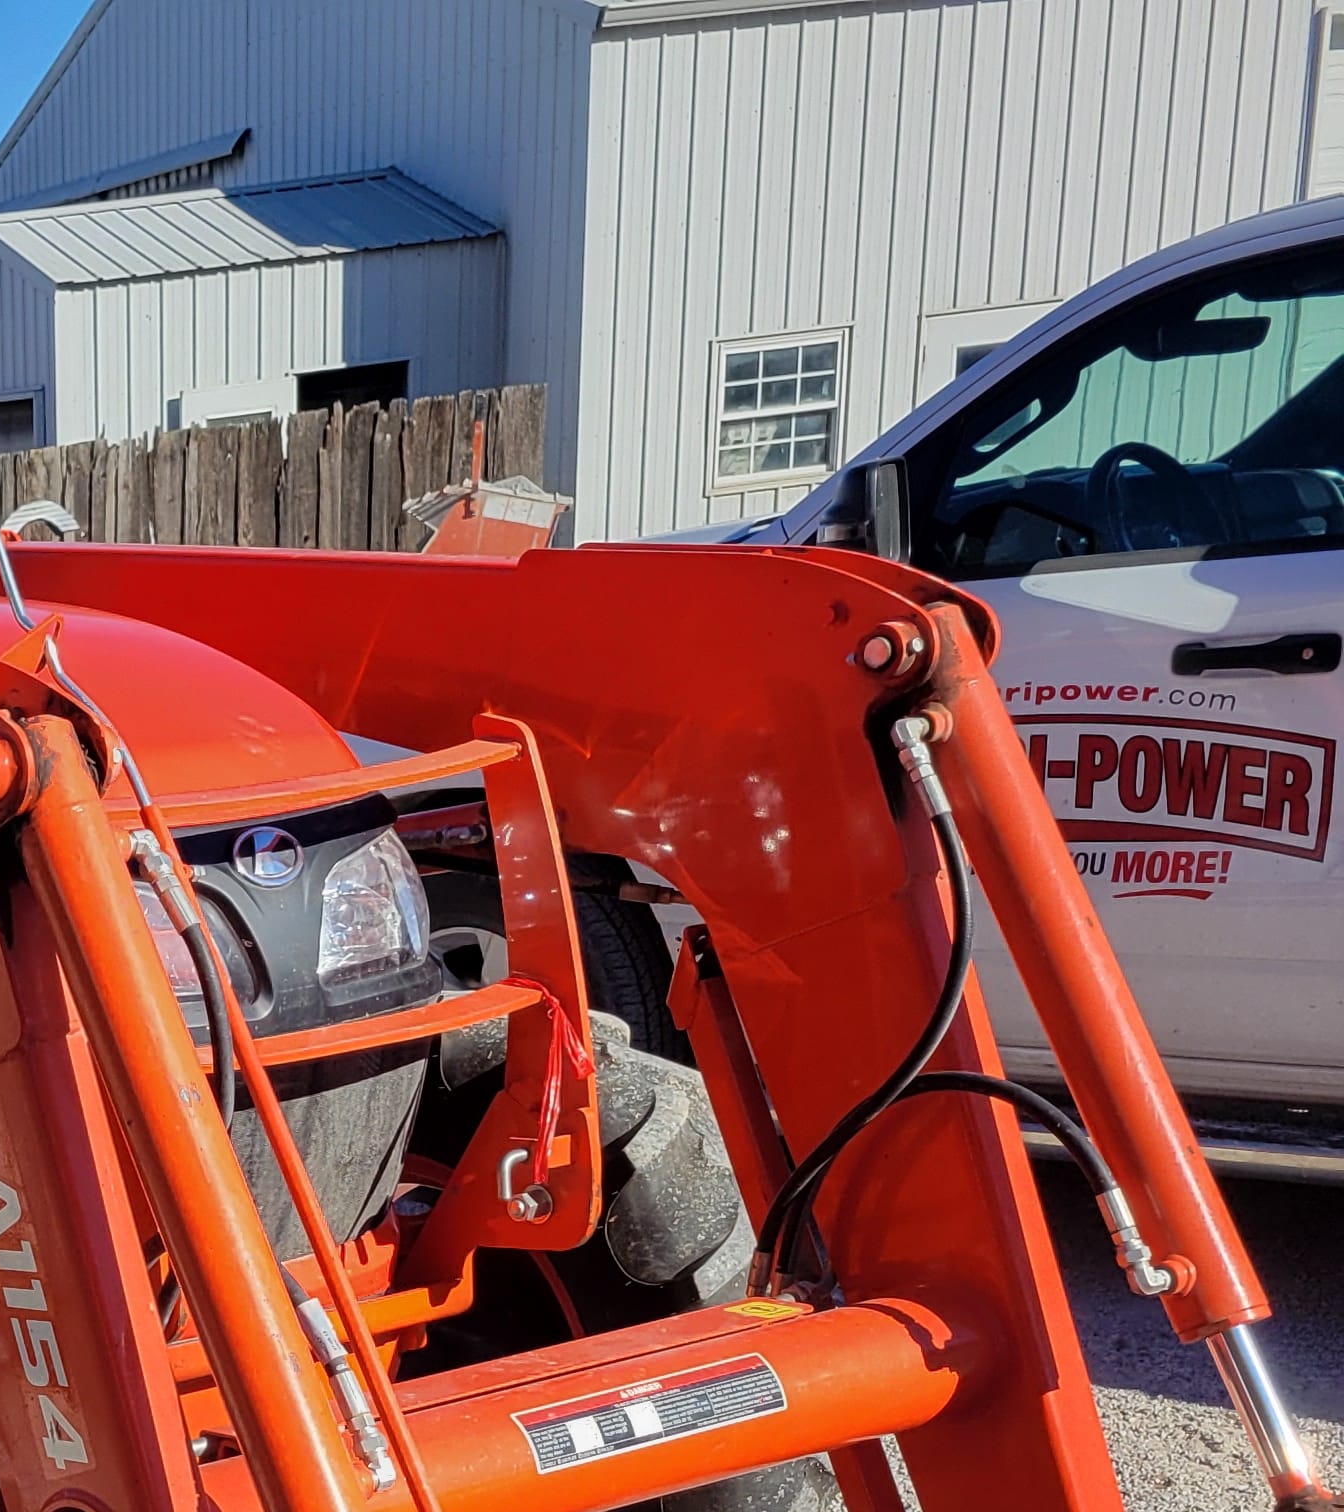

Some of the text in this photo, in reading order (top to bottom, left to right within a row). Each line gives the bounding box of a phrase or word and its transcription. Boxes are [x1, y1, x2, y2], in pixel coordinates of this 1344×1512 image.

[996, 681, 1236, 711] ripower.com
[1018, 733, 1313, 837] I-POWER
[1070, 850, 1233, 884] OU MORE!
[626, 1381, 663, 1397] DANGER
